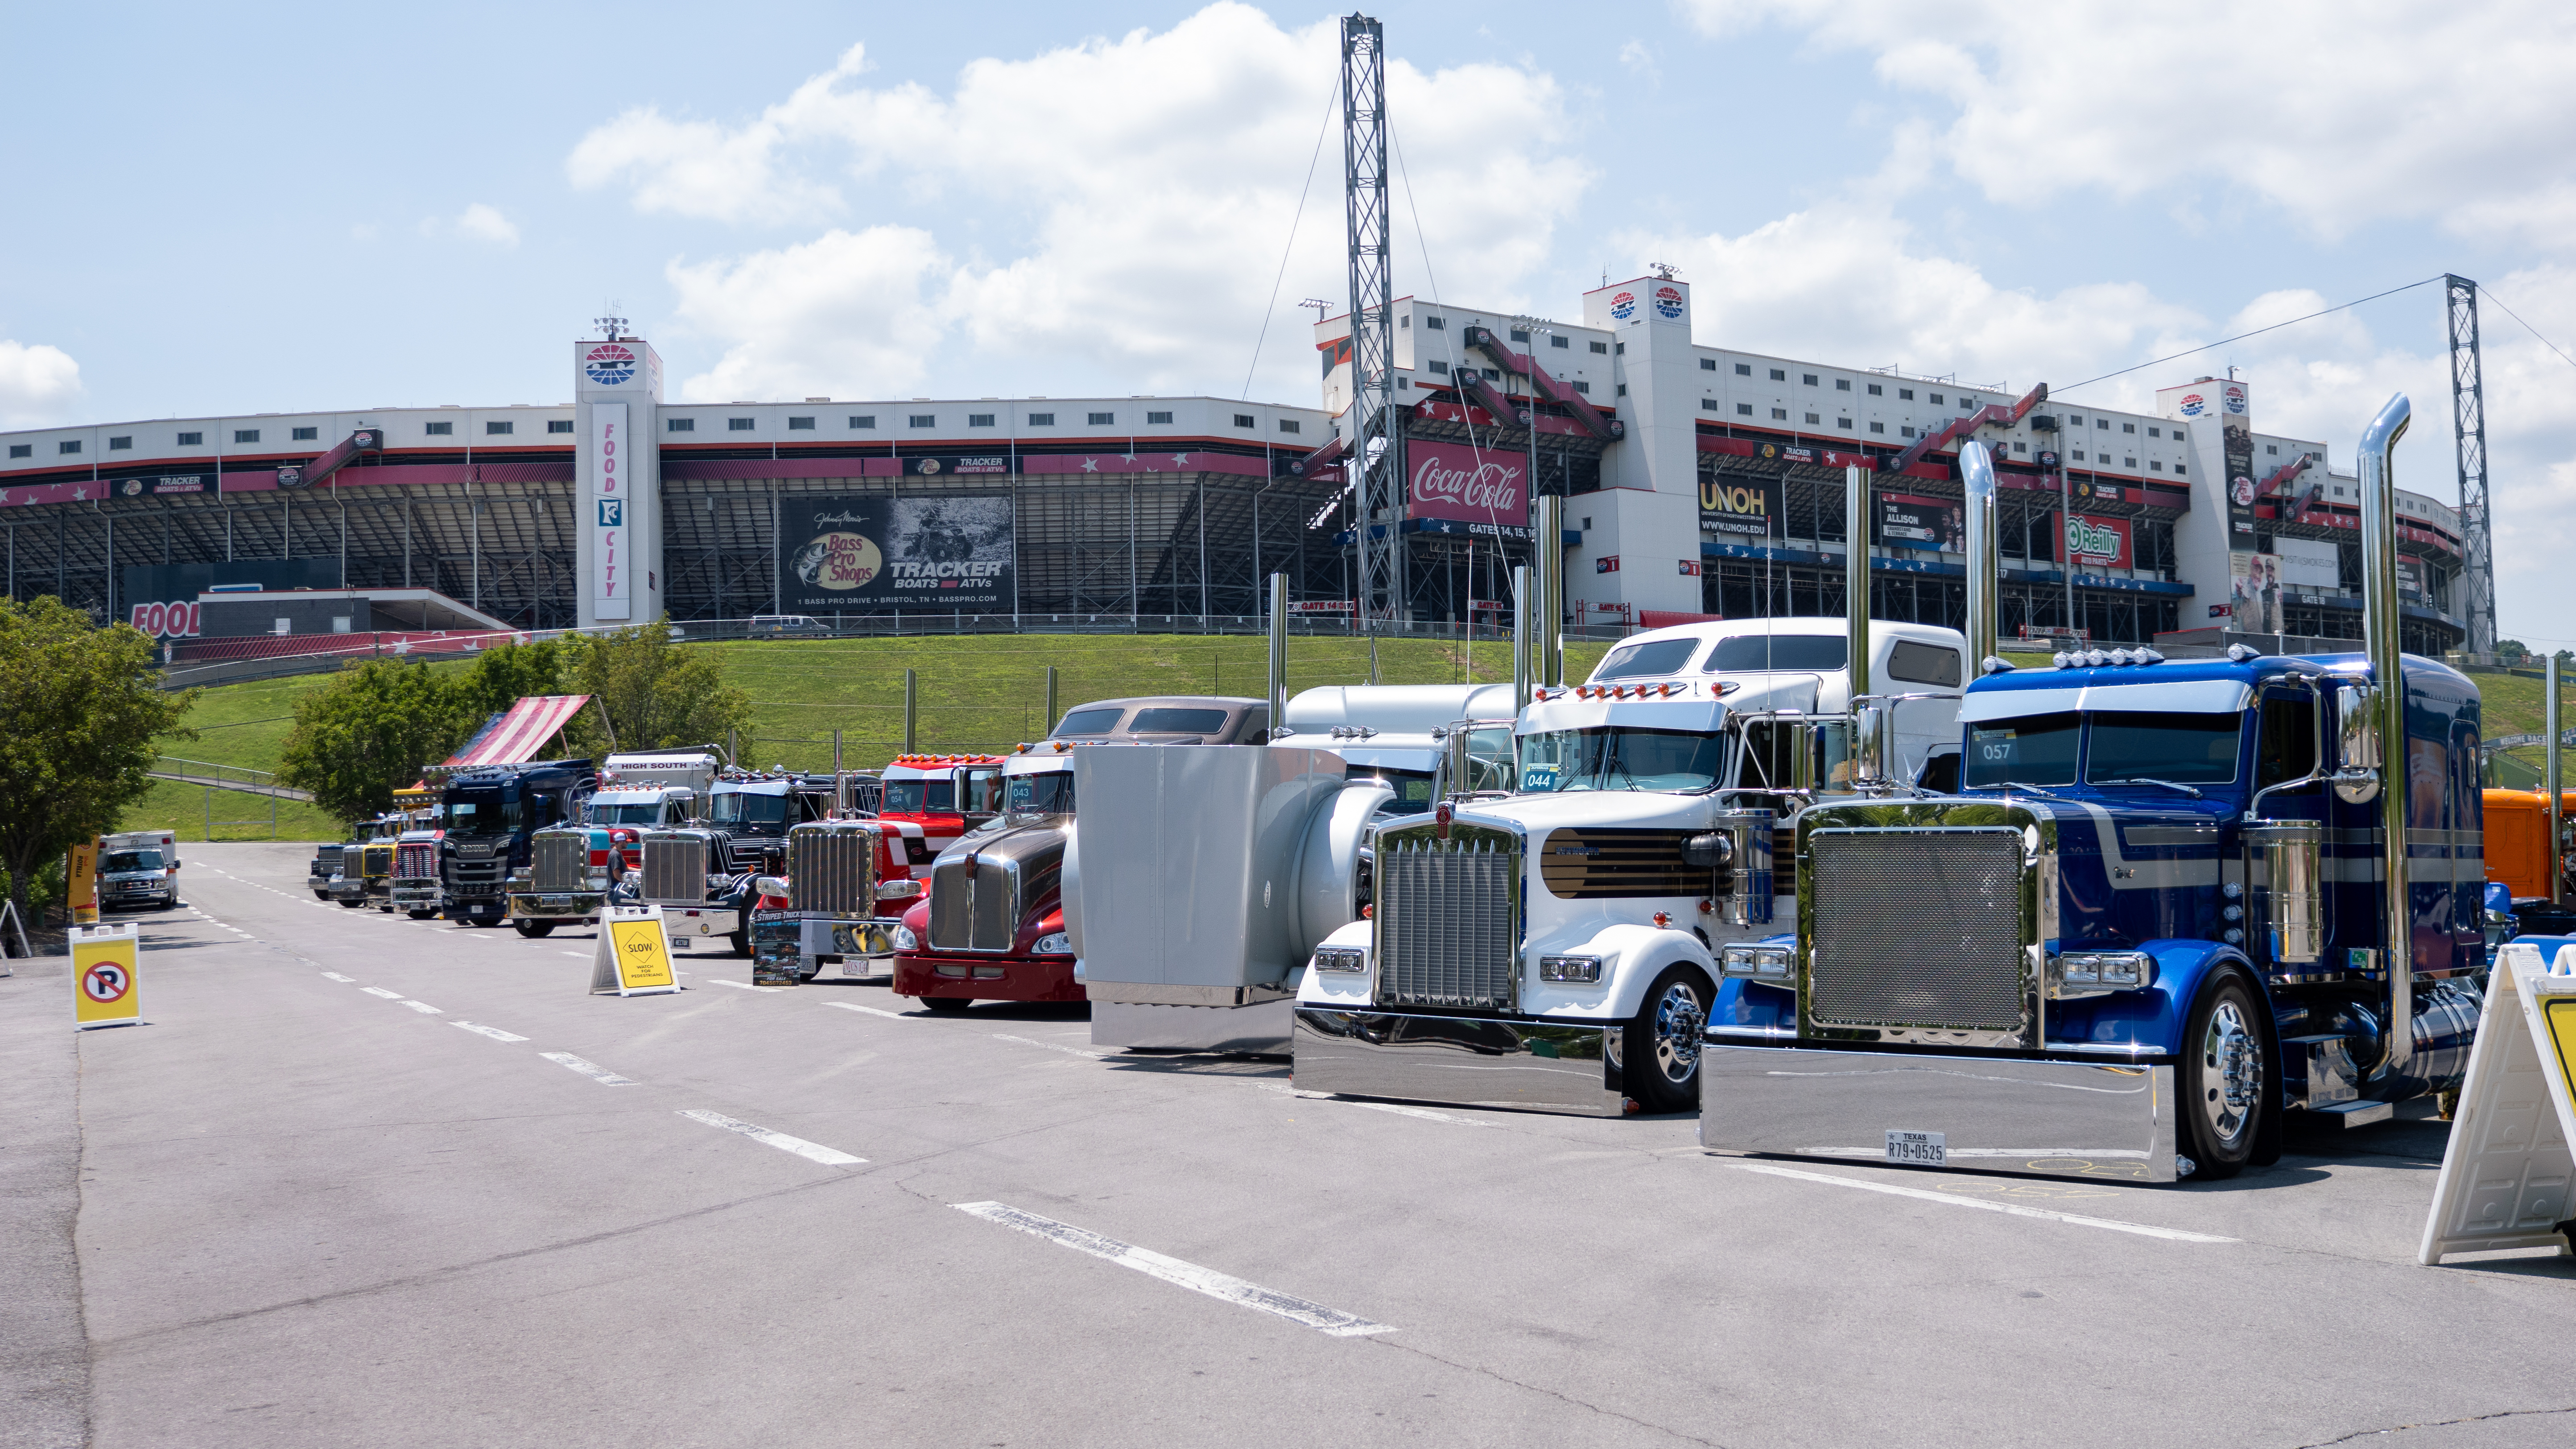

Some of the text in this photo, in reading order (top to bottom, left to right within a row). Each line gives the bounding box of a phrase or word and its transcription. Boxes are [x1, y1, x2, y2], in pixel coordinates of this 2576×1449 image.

[1786, 447, 1811, 456] TRACKER
[604, 424, 616, 492] FOOD
[160, 476, 201, 486] TRACKER
[2097, 485, 2116, 493] TRACKER
[1700, 478, 1764, 515] UNOH
[1887, 513, 1918, 525] ALLISON
[1469, 524, 1499, 534] GATES
[1501, 526, 1513, 537] 14,
[1514, 528, 1526, 539] 15,
[1701, 521, 1765, 534] WWW.UNOH.EDU
[828, 534, 863, 551] Bass
[605, 531, 615, 597] CITY
[828, 550, 855, 566] Pro
[829, 564, 873, 584] Shops
[891, 561, 1002, 577] TRACKER
[2000, 569, 2007, 578] 17
[894, 579, 992, 588] BOATS ATVs
[1477, 601, 1494, 609] GATE
[2302, 595, 2325, 604] GATE 18
[2501, 735, 2526, 745] WELCOME
[2527, 735, 2547, 743] RACE
[1983, 744, 2010, 760] 057
[1528, 774, 1550, 787] 044
[1013, 788, 1029, 797] 043
[758, 911, 800, 921] STRIPED TRUCK
[628, 943, 652, 952] SLOW
